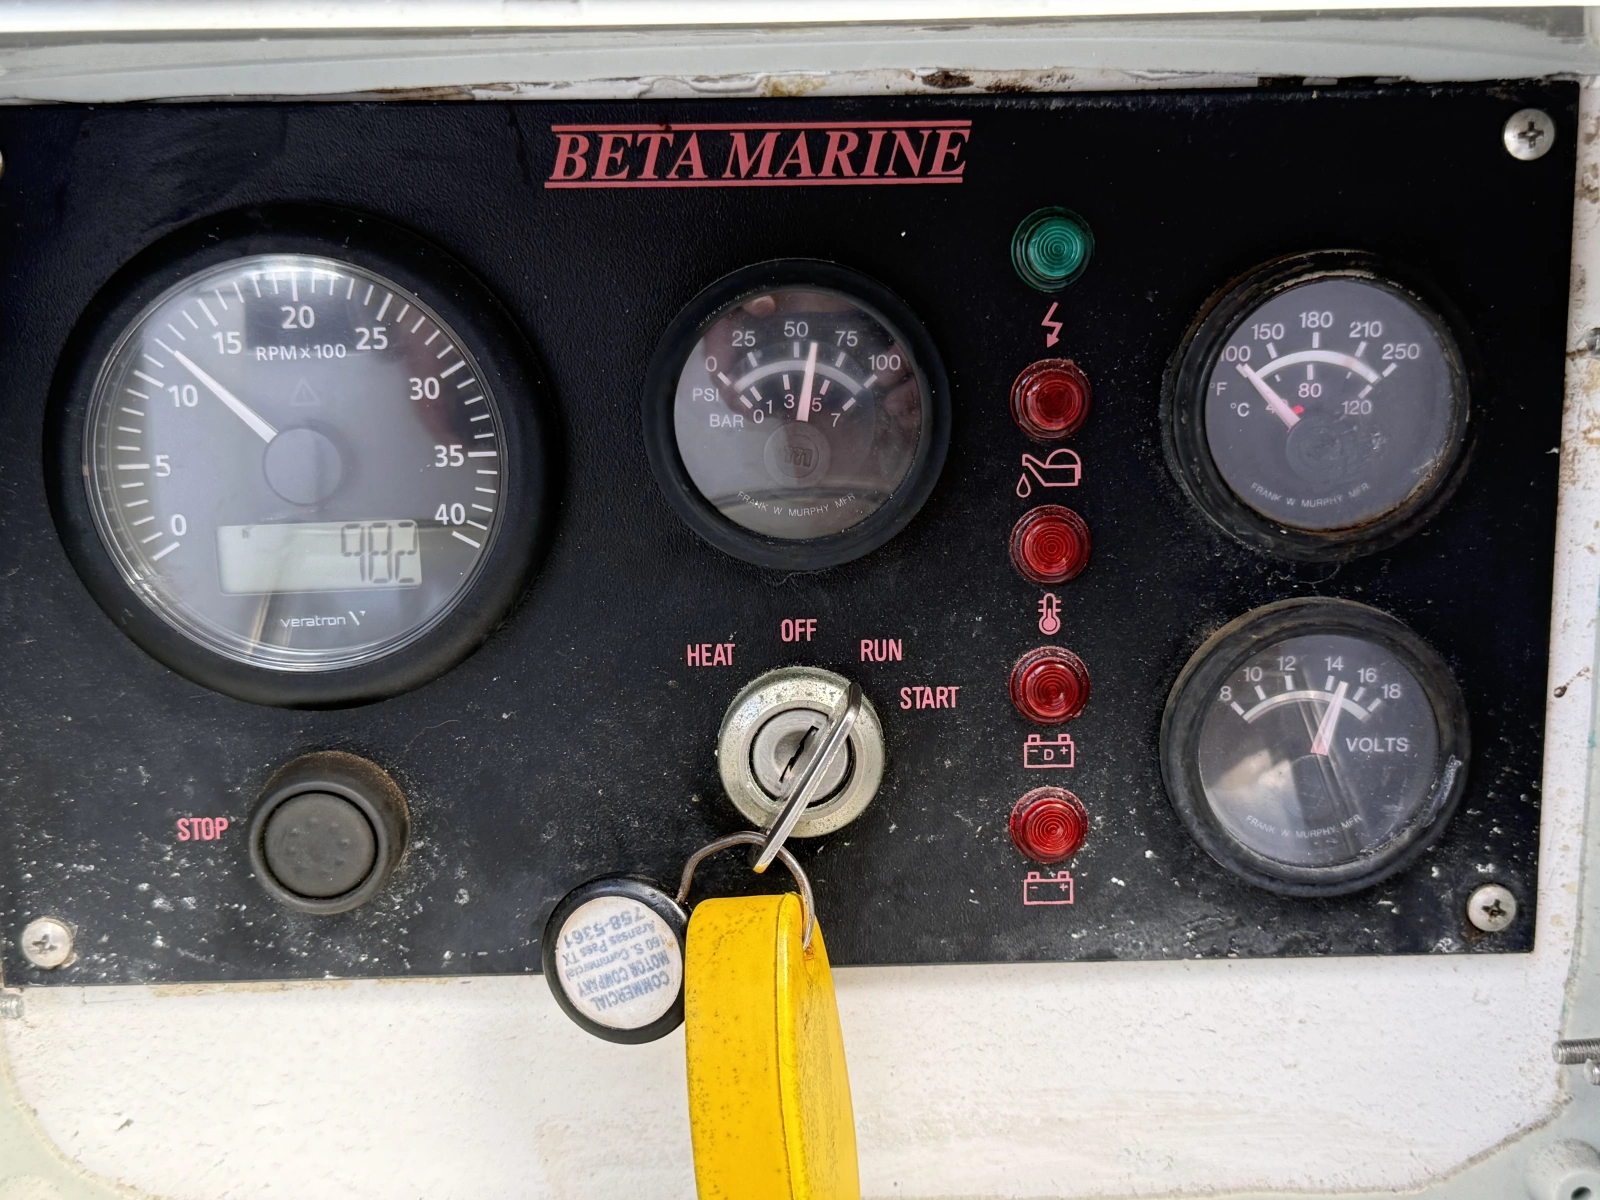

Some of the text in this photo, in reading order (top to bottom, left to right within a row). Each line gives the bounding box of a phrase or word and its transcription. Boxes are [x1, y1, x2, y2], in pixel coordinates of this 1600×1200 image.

[549, 129, 971, 180] BETA MARINE
[281, 307, 315, 328] 20
[1299, 311, 1333, 328] 180
[784, 322, 808, 337] 50
[1251, 324, 1285, 340] 150
[1349, 321, 1382, 338] 210
[212, 332, 242, 355] 15
[355, 328, 388, 350] 25
[732, 331, 756, 347] 25
[835, 331, 858, 347] 75
[256, 346, 297, 361] RPM
[1382, 344, 1420, 360] 250
[705, 356, 718, 372] 0
[868, 355, 901, 371] 100
[169, 385, 198, 407] 10
[409, 378, 440, 400] 30
[692, 389, 719, 401] PSI
[1298, 383, 1321, 398] 80
[766, 400, 772, 413] 1
[784, 394, 795, 408] 3
[811, 398, 822, 411] 5
[1342, 401, 1372, 415] 120
[709, 414, 744, 428] BAR
[753, 409, 764, 423] 0
[830, 413, 841, 427] 7
[434, 445, 464, 467] 35
[155, 456, 171, 477] 5
[737, 490, 856, 516] FRANK W MURPHY MFR
[1250, 483, 1370, 508] FRANK W MURPHY MFR
[434, 503, 466, 525] 40
[170, 514, 187, 536] 0
[341, 523, 417, 583] 982
[281, 615, 346, 628] veratron
[781, 619, 817, 642] OFF
[687, 643, 735, 667] HEAT
[860, 639, 902, 661] RUN
[1277, 656, 1296, 671] 12
[1325, 656, 1344, 671] 14
[1243, 667, 1263, 682] 10
[1358, 668, 1377, 683] 16
[900, 686, 959, 710] START
[1219, 686, 1232, 701] 8
[1382, 684, 1401, 699] 18
[1346, 738, 1409, 752] VOLTS
[1044, 749, 1055, 761] D
[177, 817, 228, 841] STOP
[1245, 814, 1362, 839] FRANK W MURPHY MFR
[580, 939, 608, 957] Pass
[562, 951, 580, 966] TX
[576, 950, 670, 997] MOTOR COMPANY
[590, 970, 671, 1011] COMMERCIAL
